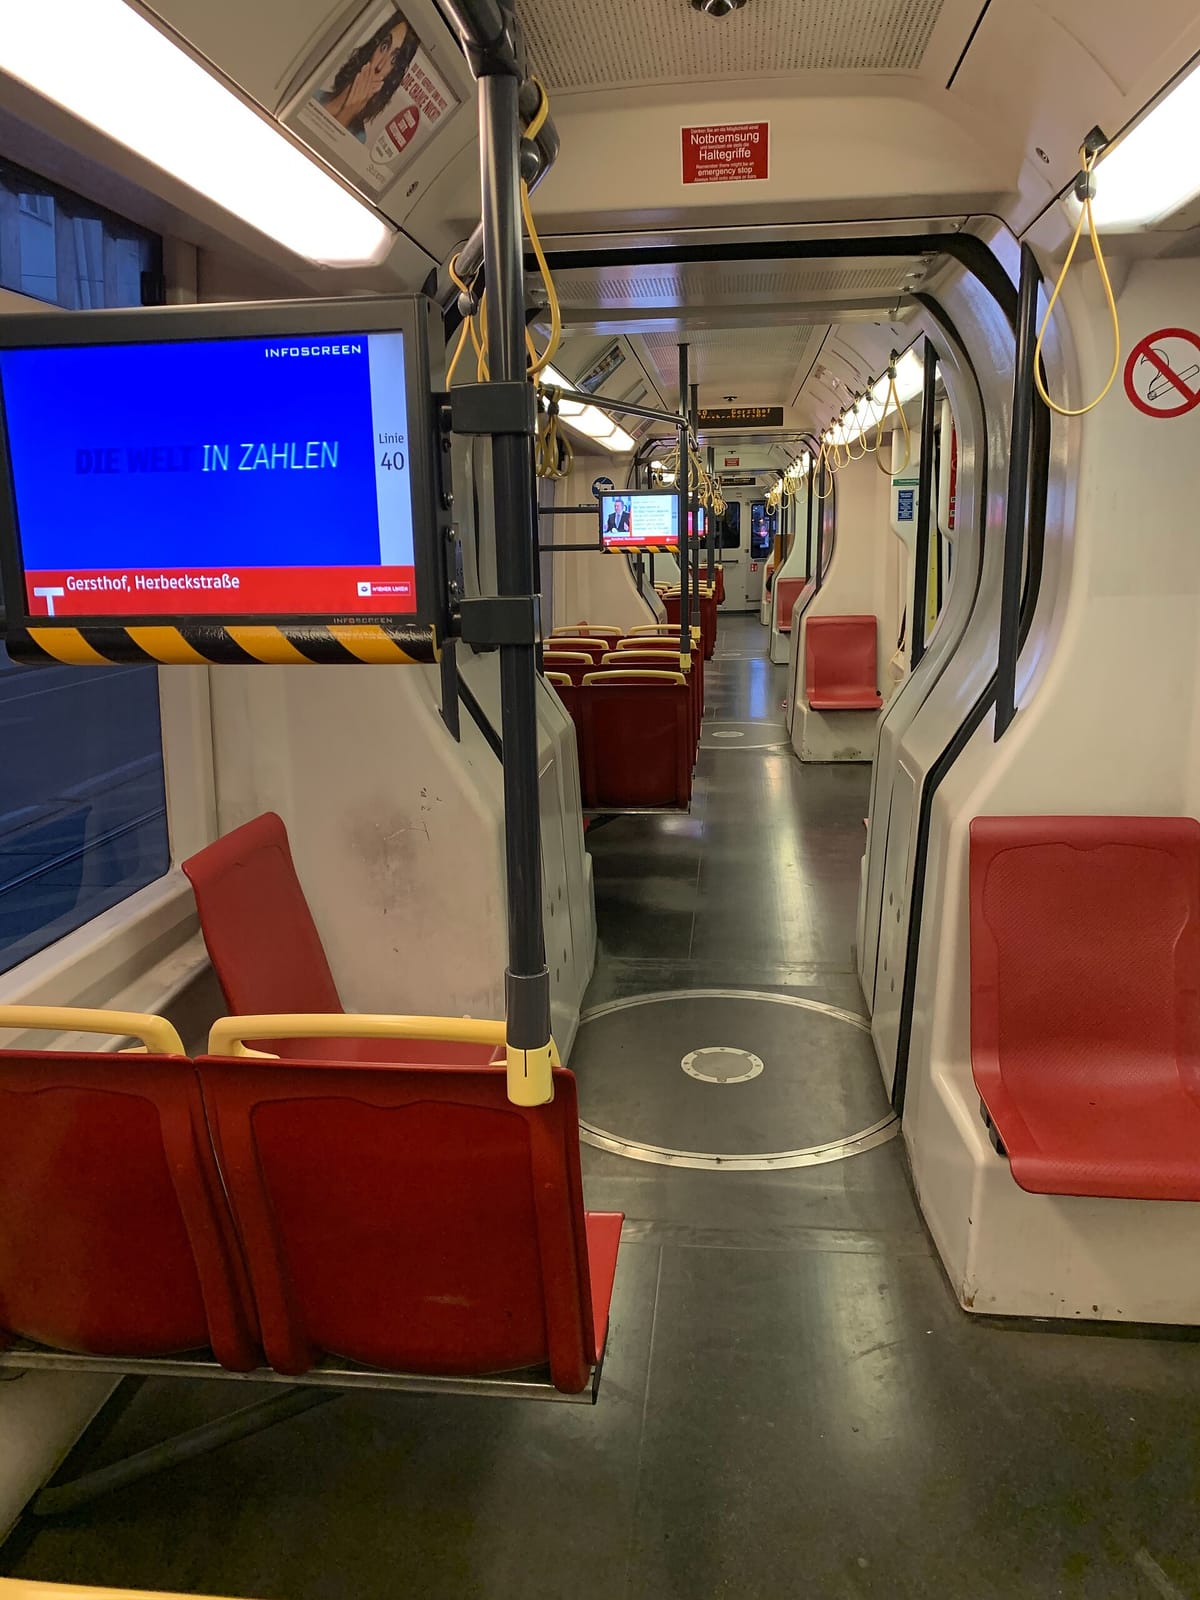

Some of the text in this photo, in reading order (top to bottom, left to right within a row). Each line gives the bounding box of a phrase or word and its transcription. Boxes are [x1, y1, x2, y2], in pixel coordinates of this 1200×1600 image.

[690, 132, 760, 145] Notbremsung
[699, 147, 751, 161] Haltegriffe
[697, 166, 753, 177] emergency stop
[265, 344, 362, 359] INFOSCREEN
[378, 432, 404, 444] Linie
[76, 441, 339, 475] DIE WELT IN ZAHLEN
[380, 451, 405, 471] 40
[66, 574, 240, 592] Gersthof, Herbeckstraße
